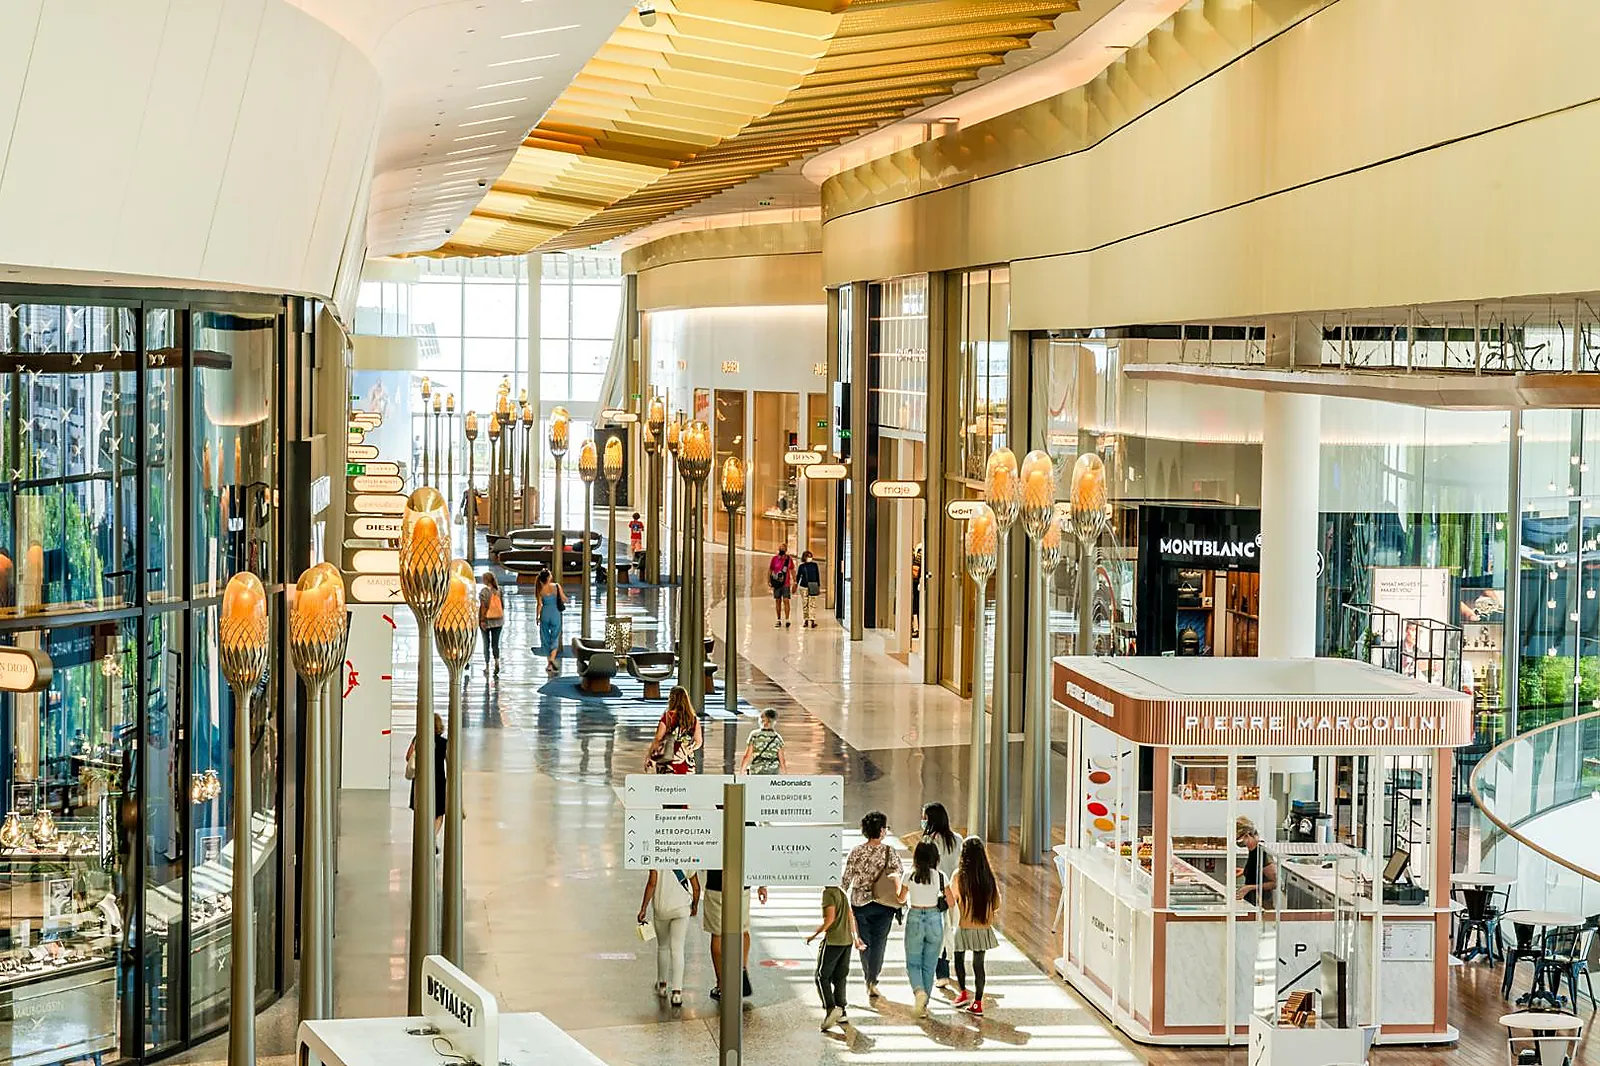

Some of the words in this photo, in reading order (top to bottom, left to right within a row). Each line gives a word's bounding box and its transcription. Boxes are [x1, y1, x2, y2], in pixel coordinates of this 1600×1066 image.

[884, 486, 910, 495] maje
[1160, 538, 1255, 558] MONTBLANC
[7, 662, 28, 673] DIOR
[1185, 716, 1282, 730] PIERRE
[1297, 716, 1446, 730] MARCOLINI
[655, 814, 677, 823] Espace
[654, 846, 681, 854] Rooftop
[654, 856, 679, 865] Parking
[427, 975, 473, 1028] DEVIALET
